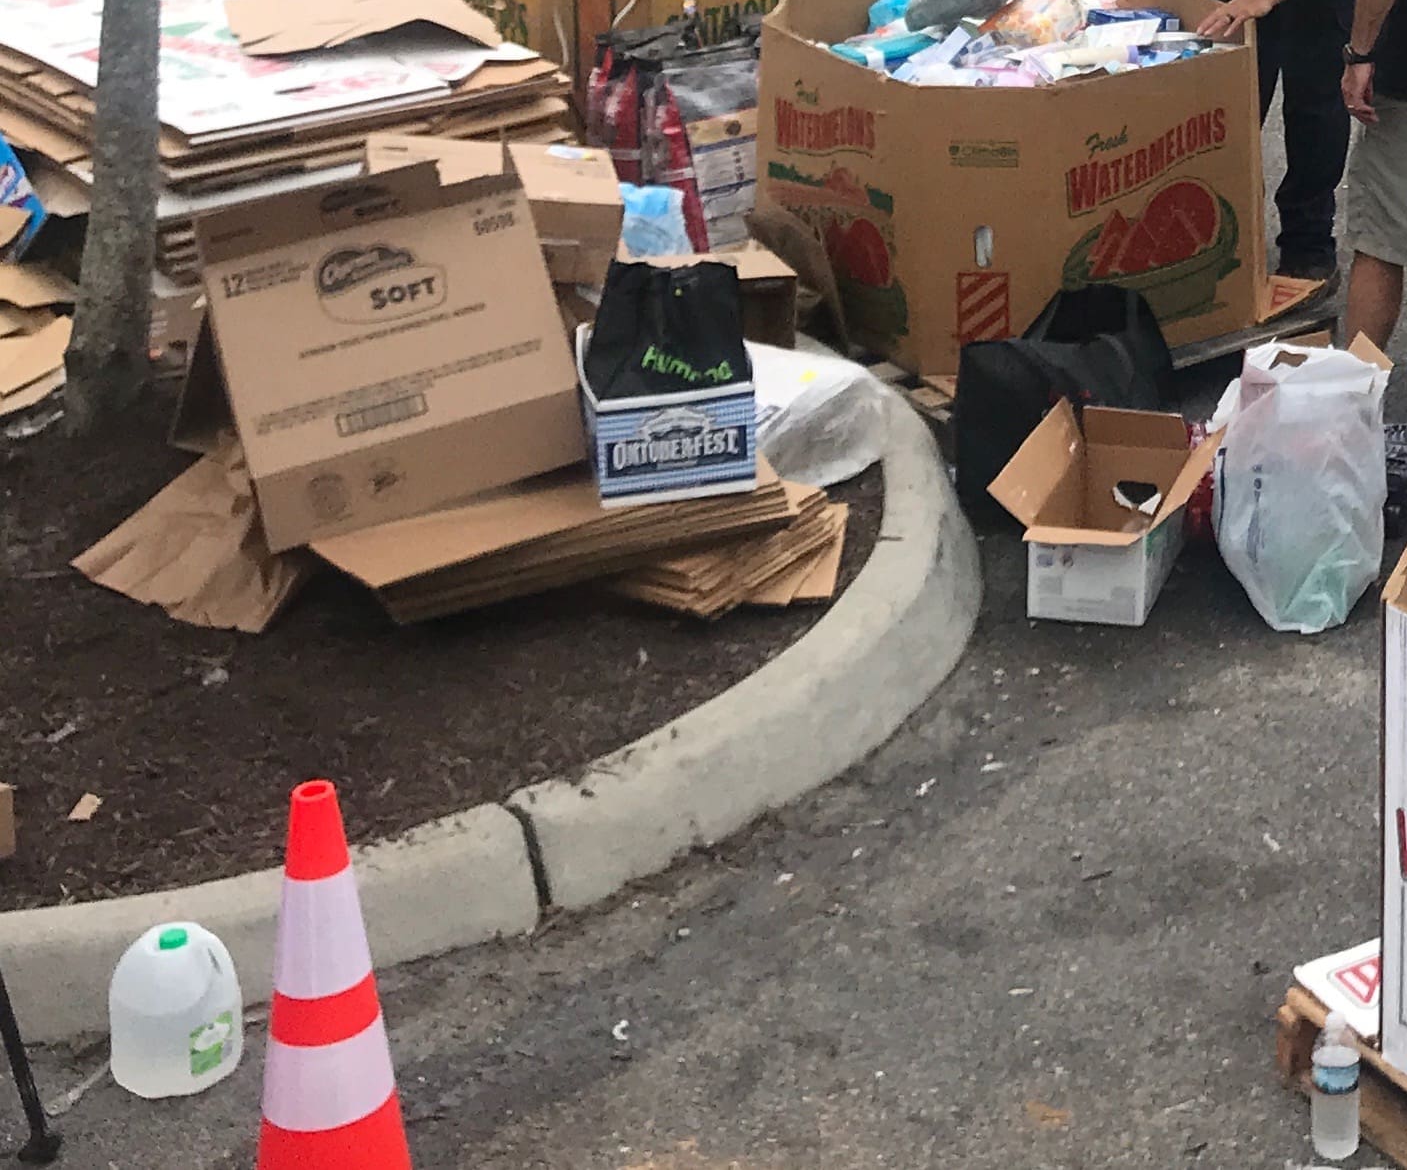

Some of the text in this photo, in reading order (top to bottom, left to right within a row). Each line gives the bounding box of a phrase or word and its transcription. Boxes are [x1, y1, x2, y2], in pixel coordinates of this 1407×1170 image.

[775, 95, 876, 151] WATERMELONS
[1085, 124, 1128, 159] Fresh
[1069, 107, 1226, 213] WATERMELONS
[222, 273, 247, 299] 12
[369, 276, 437, 310] SOFT
